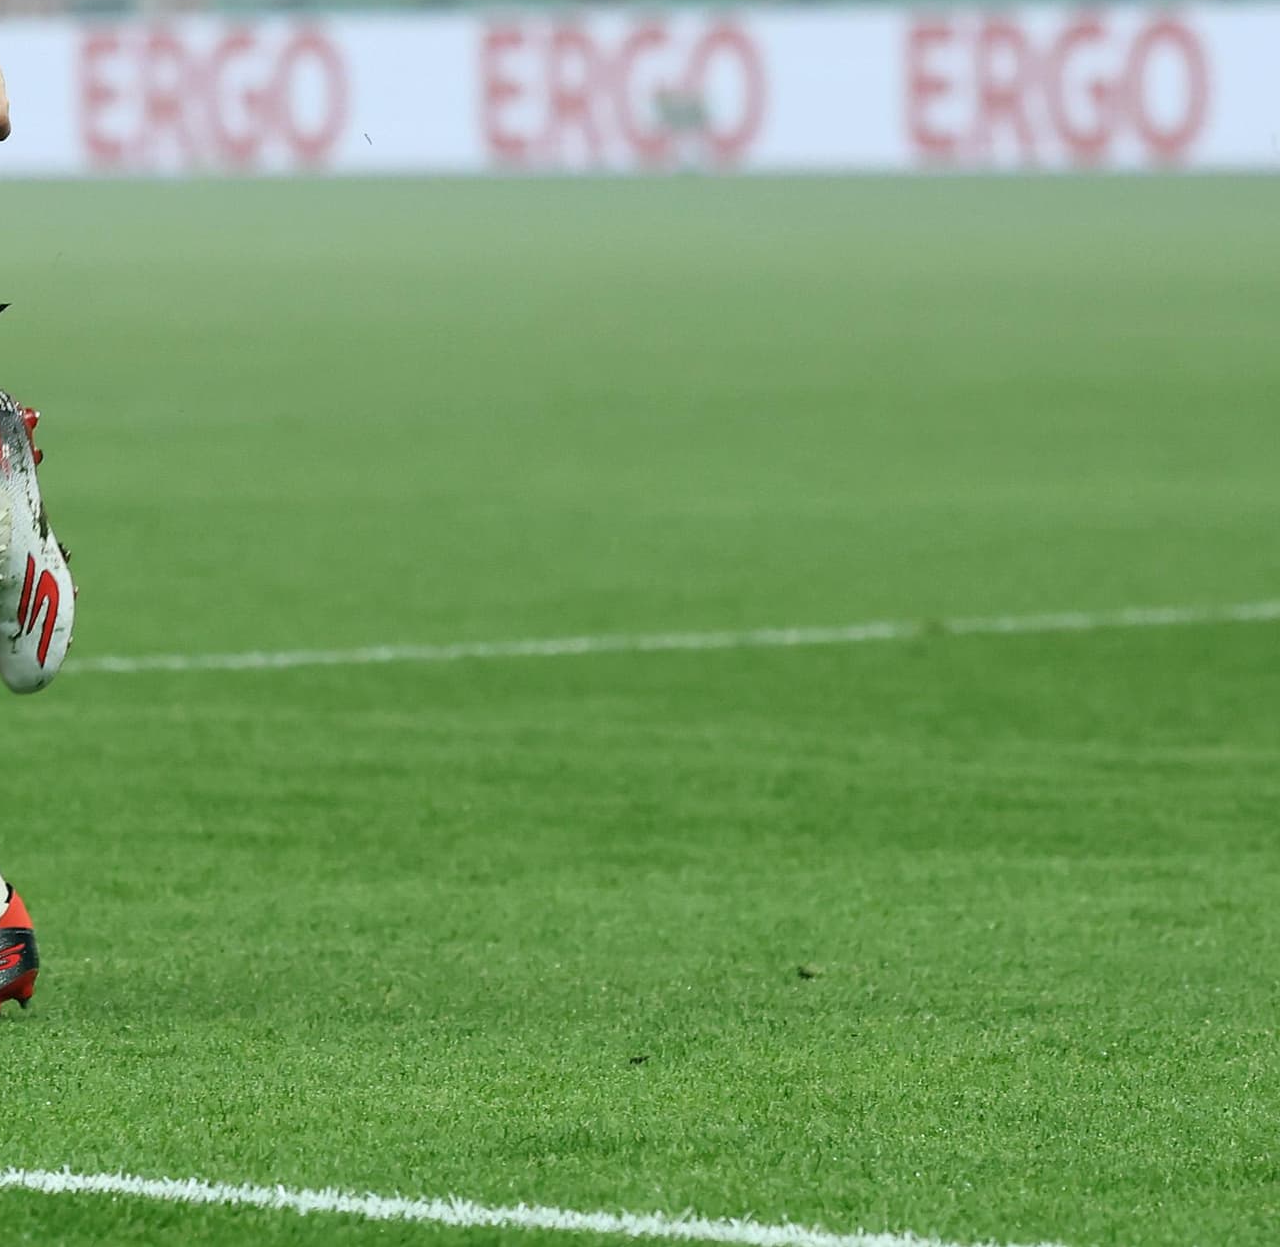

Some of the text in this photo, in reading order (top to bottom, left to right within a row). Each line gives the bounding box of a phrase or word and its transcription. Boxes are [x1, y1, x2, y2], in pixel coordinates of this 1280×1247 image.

[76, 21, 348, 163] ERGO
[481, 18, 770, 163] ERGO
[901, 7, 1214, 159] ERGO
